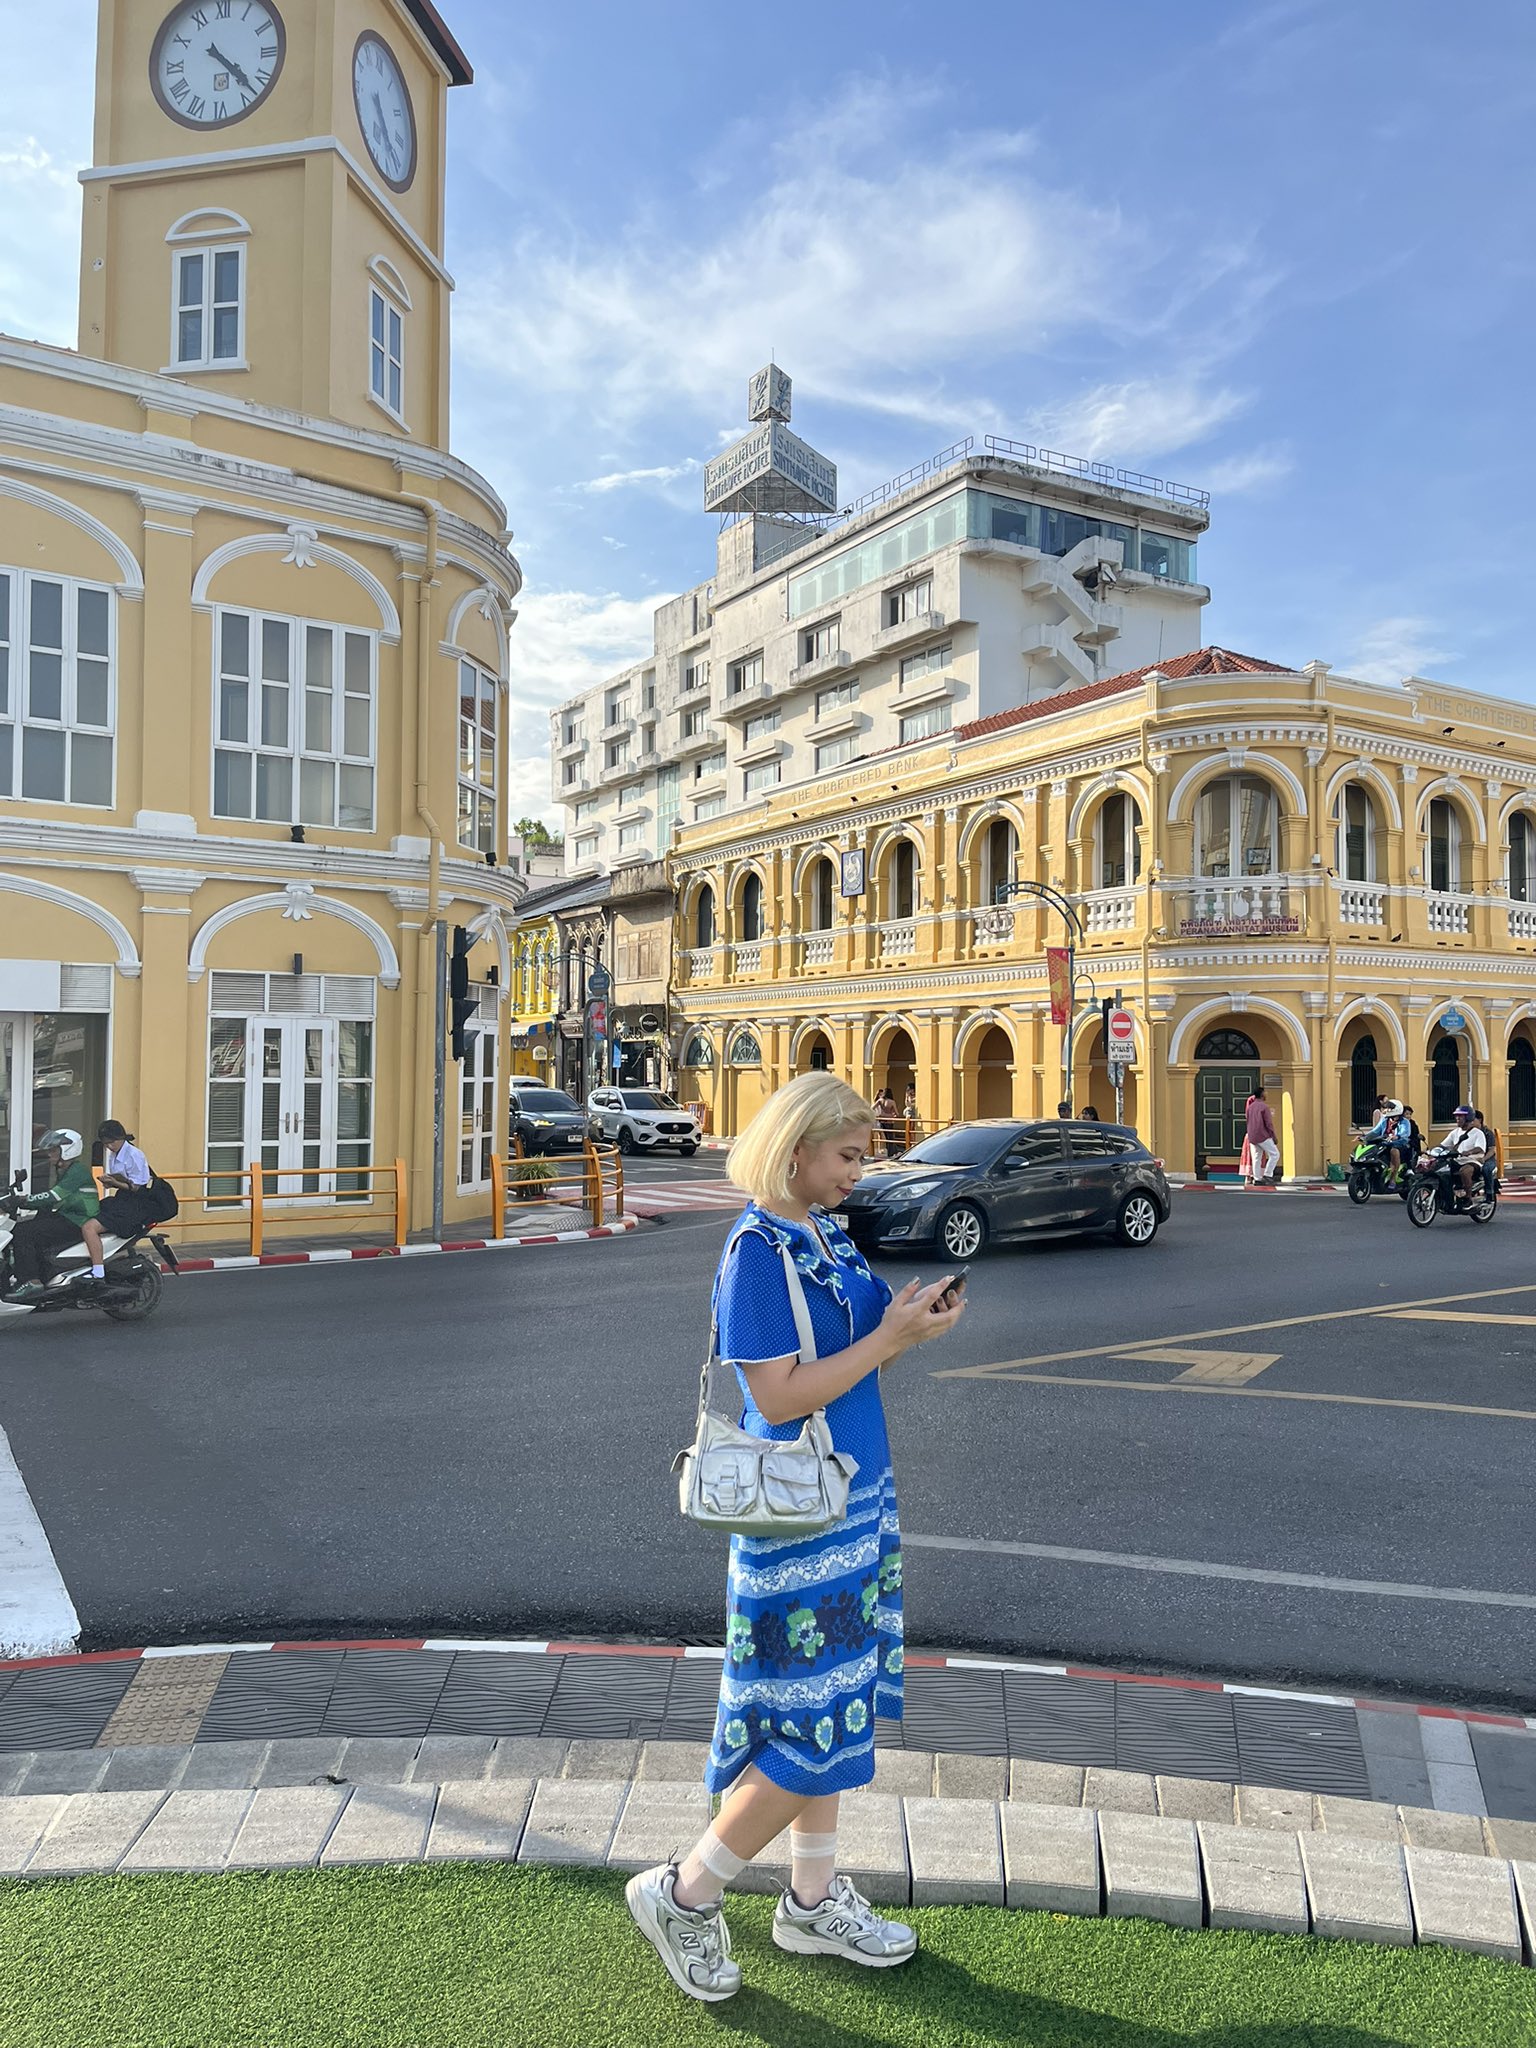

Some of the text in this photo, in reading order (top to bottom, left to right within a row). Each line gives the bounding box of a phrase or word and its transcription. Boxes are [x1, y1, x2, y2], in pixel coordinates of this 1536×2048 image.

[191, 9, 209, 31] XI
[215, 0, 231, 20] XII
[254, 18, 274, 37] II
[172, 33, 192, 49] X
[260, 46, 278, 59] III
[166, 59, 184, 76] IX
[169, 76, 191, 106] VIII
[186, 95, 206, 119] VII
[213, 101, 228, 120] VI
[743, 450, 770, 480] HOTEL
[811, 475, 836, 507] HOTEL
[1425, 696, 1451, 713] THE
[1456, 703, 1528, 730] CHARTERED
[791, 756, 919, 804] THE CHARTERED BANK
[1262, 924, 1299, 933] MUSEUM
[27, 1192, 50, 1202] Grab
[826, 1917, 851, 1937] N
[678, 1931, 701, 1951] N
